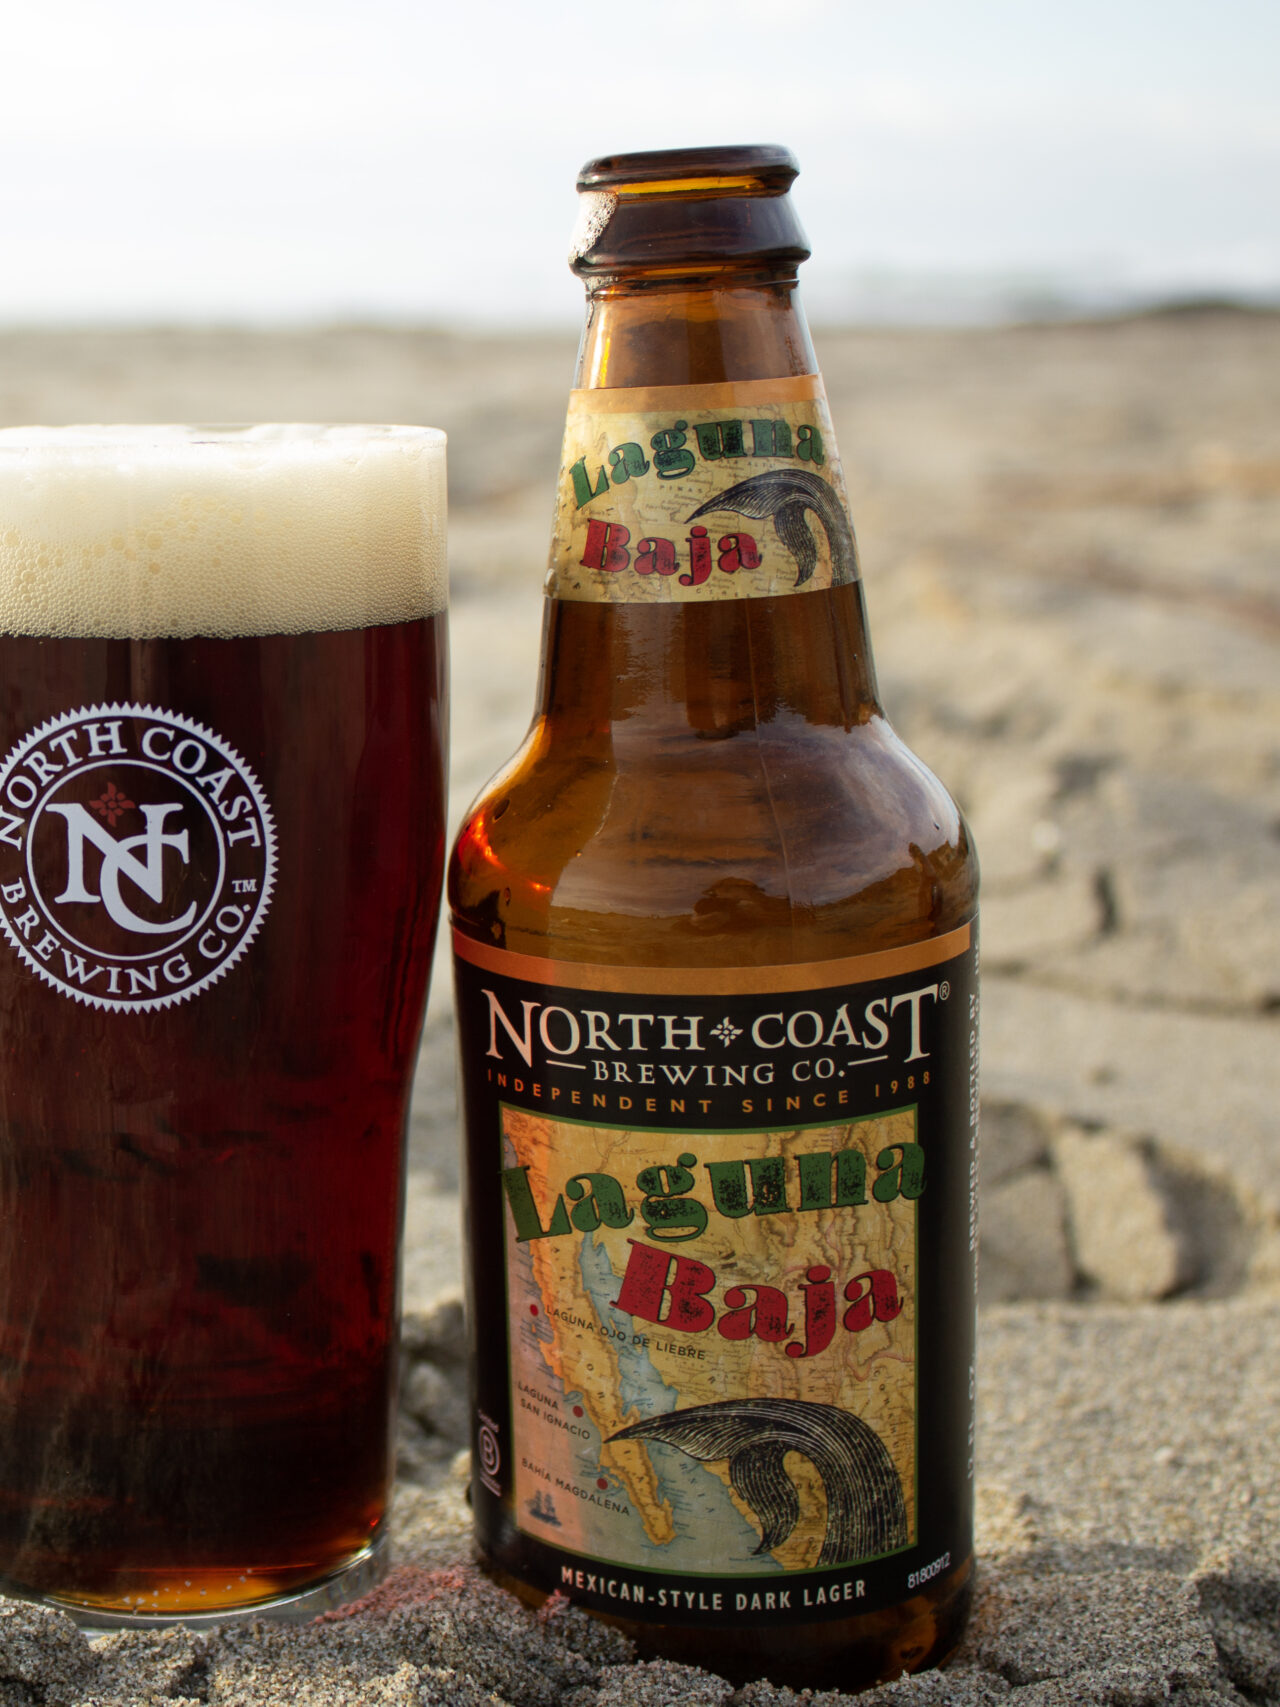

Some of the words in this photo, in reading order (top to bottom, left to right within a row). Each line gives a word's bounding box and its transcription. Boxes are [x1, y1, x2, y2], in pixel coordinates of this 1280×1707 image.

[569, 419, 826, 511] Laguna
[580, 517, 763, 587] Baja
[141, 726, 262, 848] COAST
[1, 877, 193, 995] BREWING
[197, 903, 252, 960] CO.
[480, 988, 706, 1069] NORTH
[751, 983, 939, 1064] COAST
[487, 1068, 712, 1114] INDEPENDENT
[741, 1089, 849, 1114] SINCE
[875, 1071, 930, 1098] 1988
[590, 1059, 775, 1087] BREWING
[791, 1057, 846, 1082] CO.
[500, 1142, 928, 1243] Laguna
[609, 1238, 904, 1359] Baja
[546, 1304, 595, 1333] LAGUNA
[599, 1325, 627, 1342] OJO
[631, 1335, 651, 1348] DE
[655, 1340, 706, 1361] LIEBRE
[517, 1381, 560, 1411] LAGUNA
[520, 1397, 541, 1417] SAN
[543, 1412, 591, 1441] IGNACIO
[521, 1457, 552, 1483] BAHÍA
[554, 1477, 630, 1517] MAGDALENA
[561, 1566, 723, 1611] MEXICAN-STYLE
[735, 1590, 792, 1612] DARK
[803, 1579, 867, 1607] LAGER
[907, 1551, 951, 1589] 81800912
